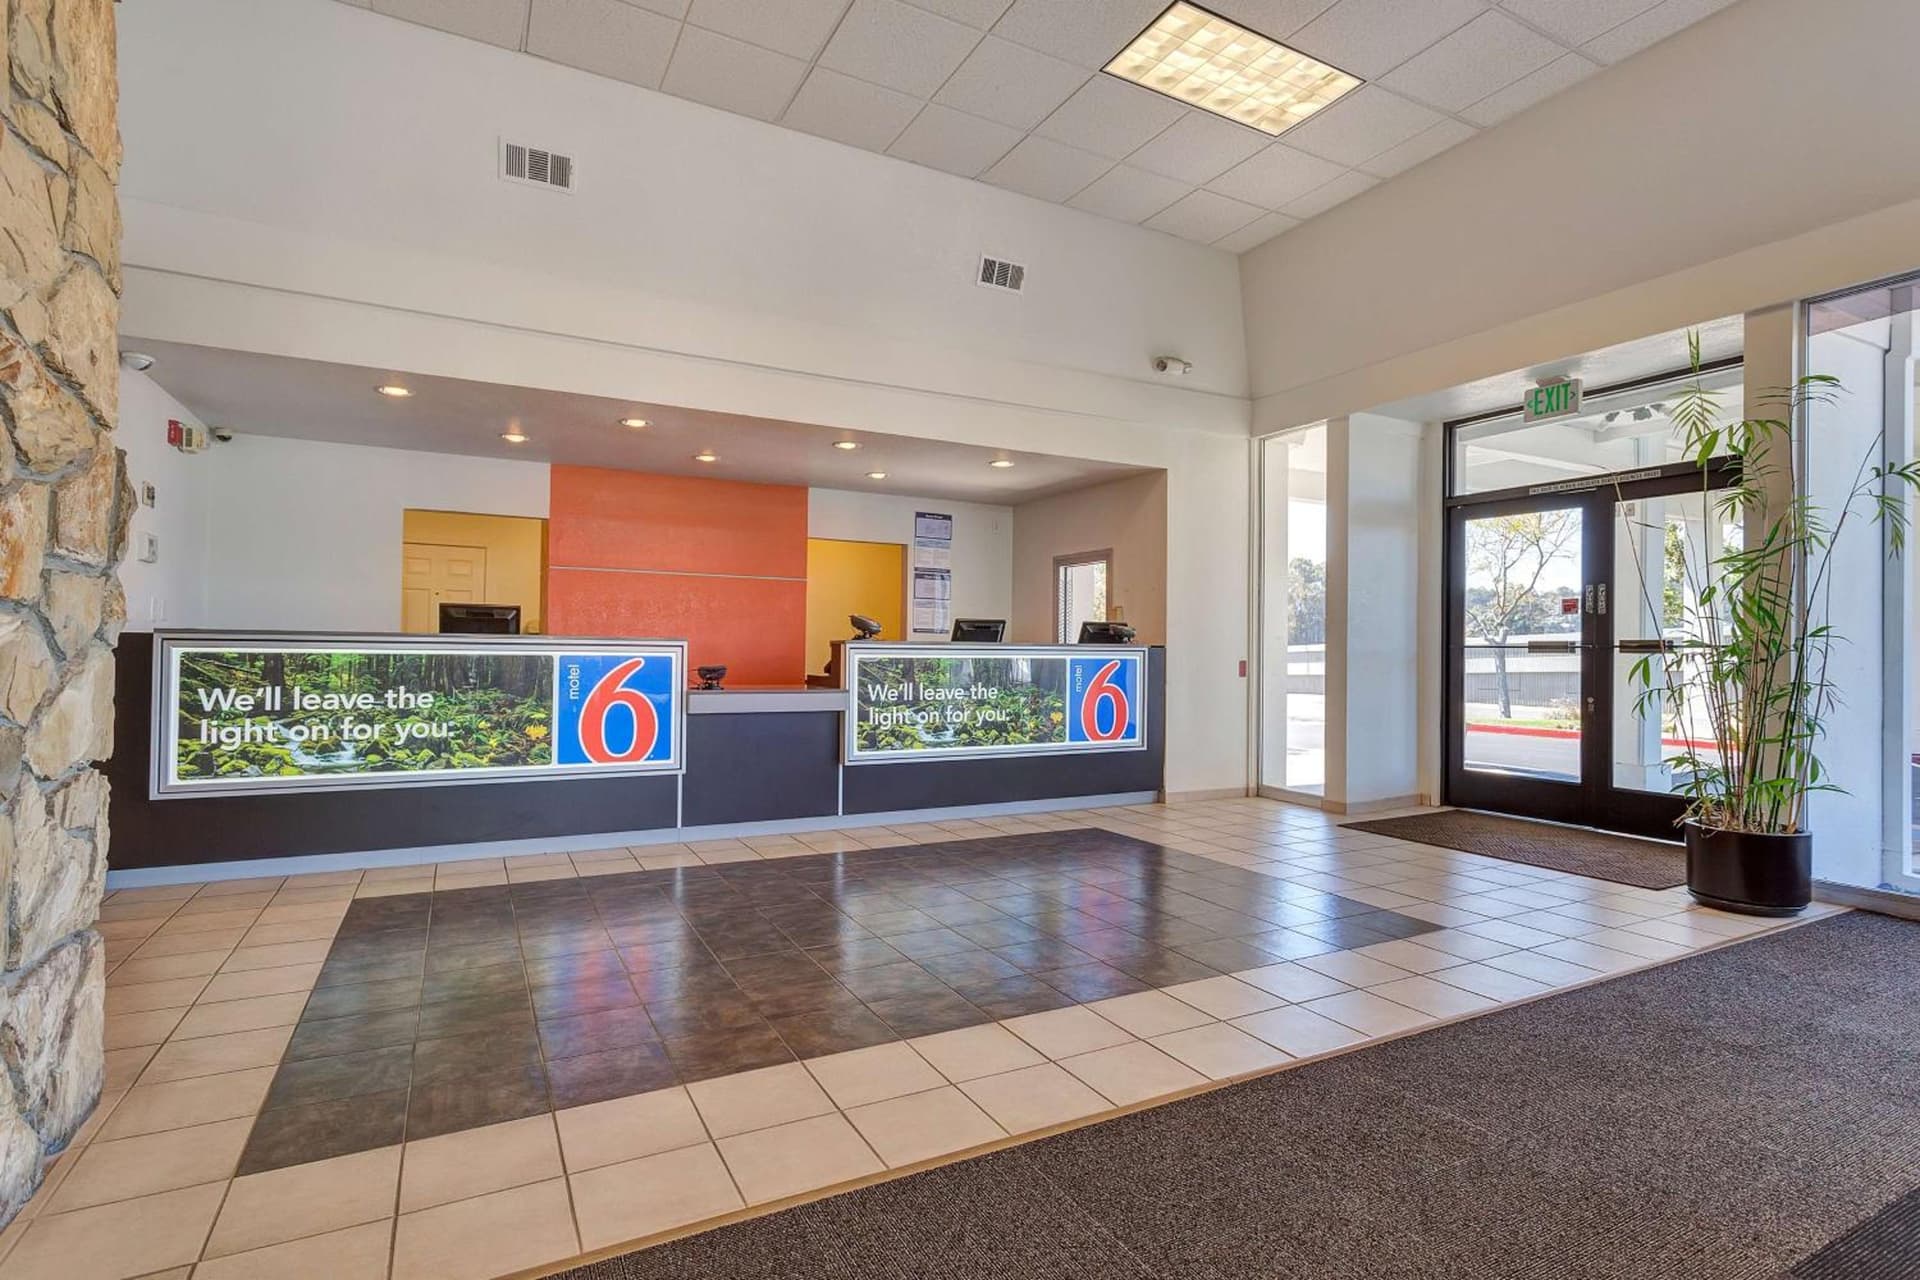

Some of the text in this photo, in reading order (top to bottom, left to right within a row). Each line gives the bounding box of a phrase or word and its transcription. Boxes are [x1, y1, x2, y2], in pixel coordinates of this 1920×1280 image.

[1534, 383, 1570, 416] EXIT
[568, 664, 580, 700] motel
[868, 682, 998, 701] We'll leave the
[1074, 664, 1083, 693] motel
[197, 686, 434, 712] We'll leave the
[578, 657, 658, 763] 6
[1081, 660, 1129, 741] 6
[200, 719, 278, 751] light
[288, 725, 330, 742] on
[340, 716, 386, 740] for
[869, 706, 912, 730] light
[918, 711, 940, 724] on
[946, 705, 971, 723] for
